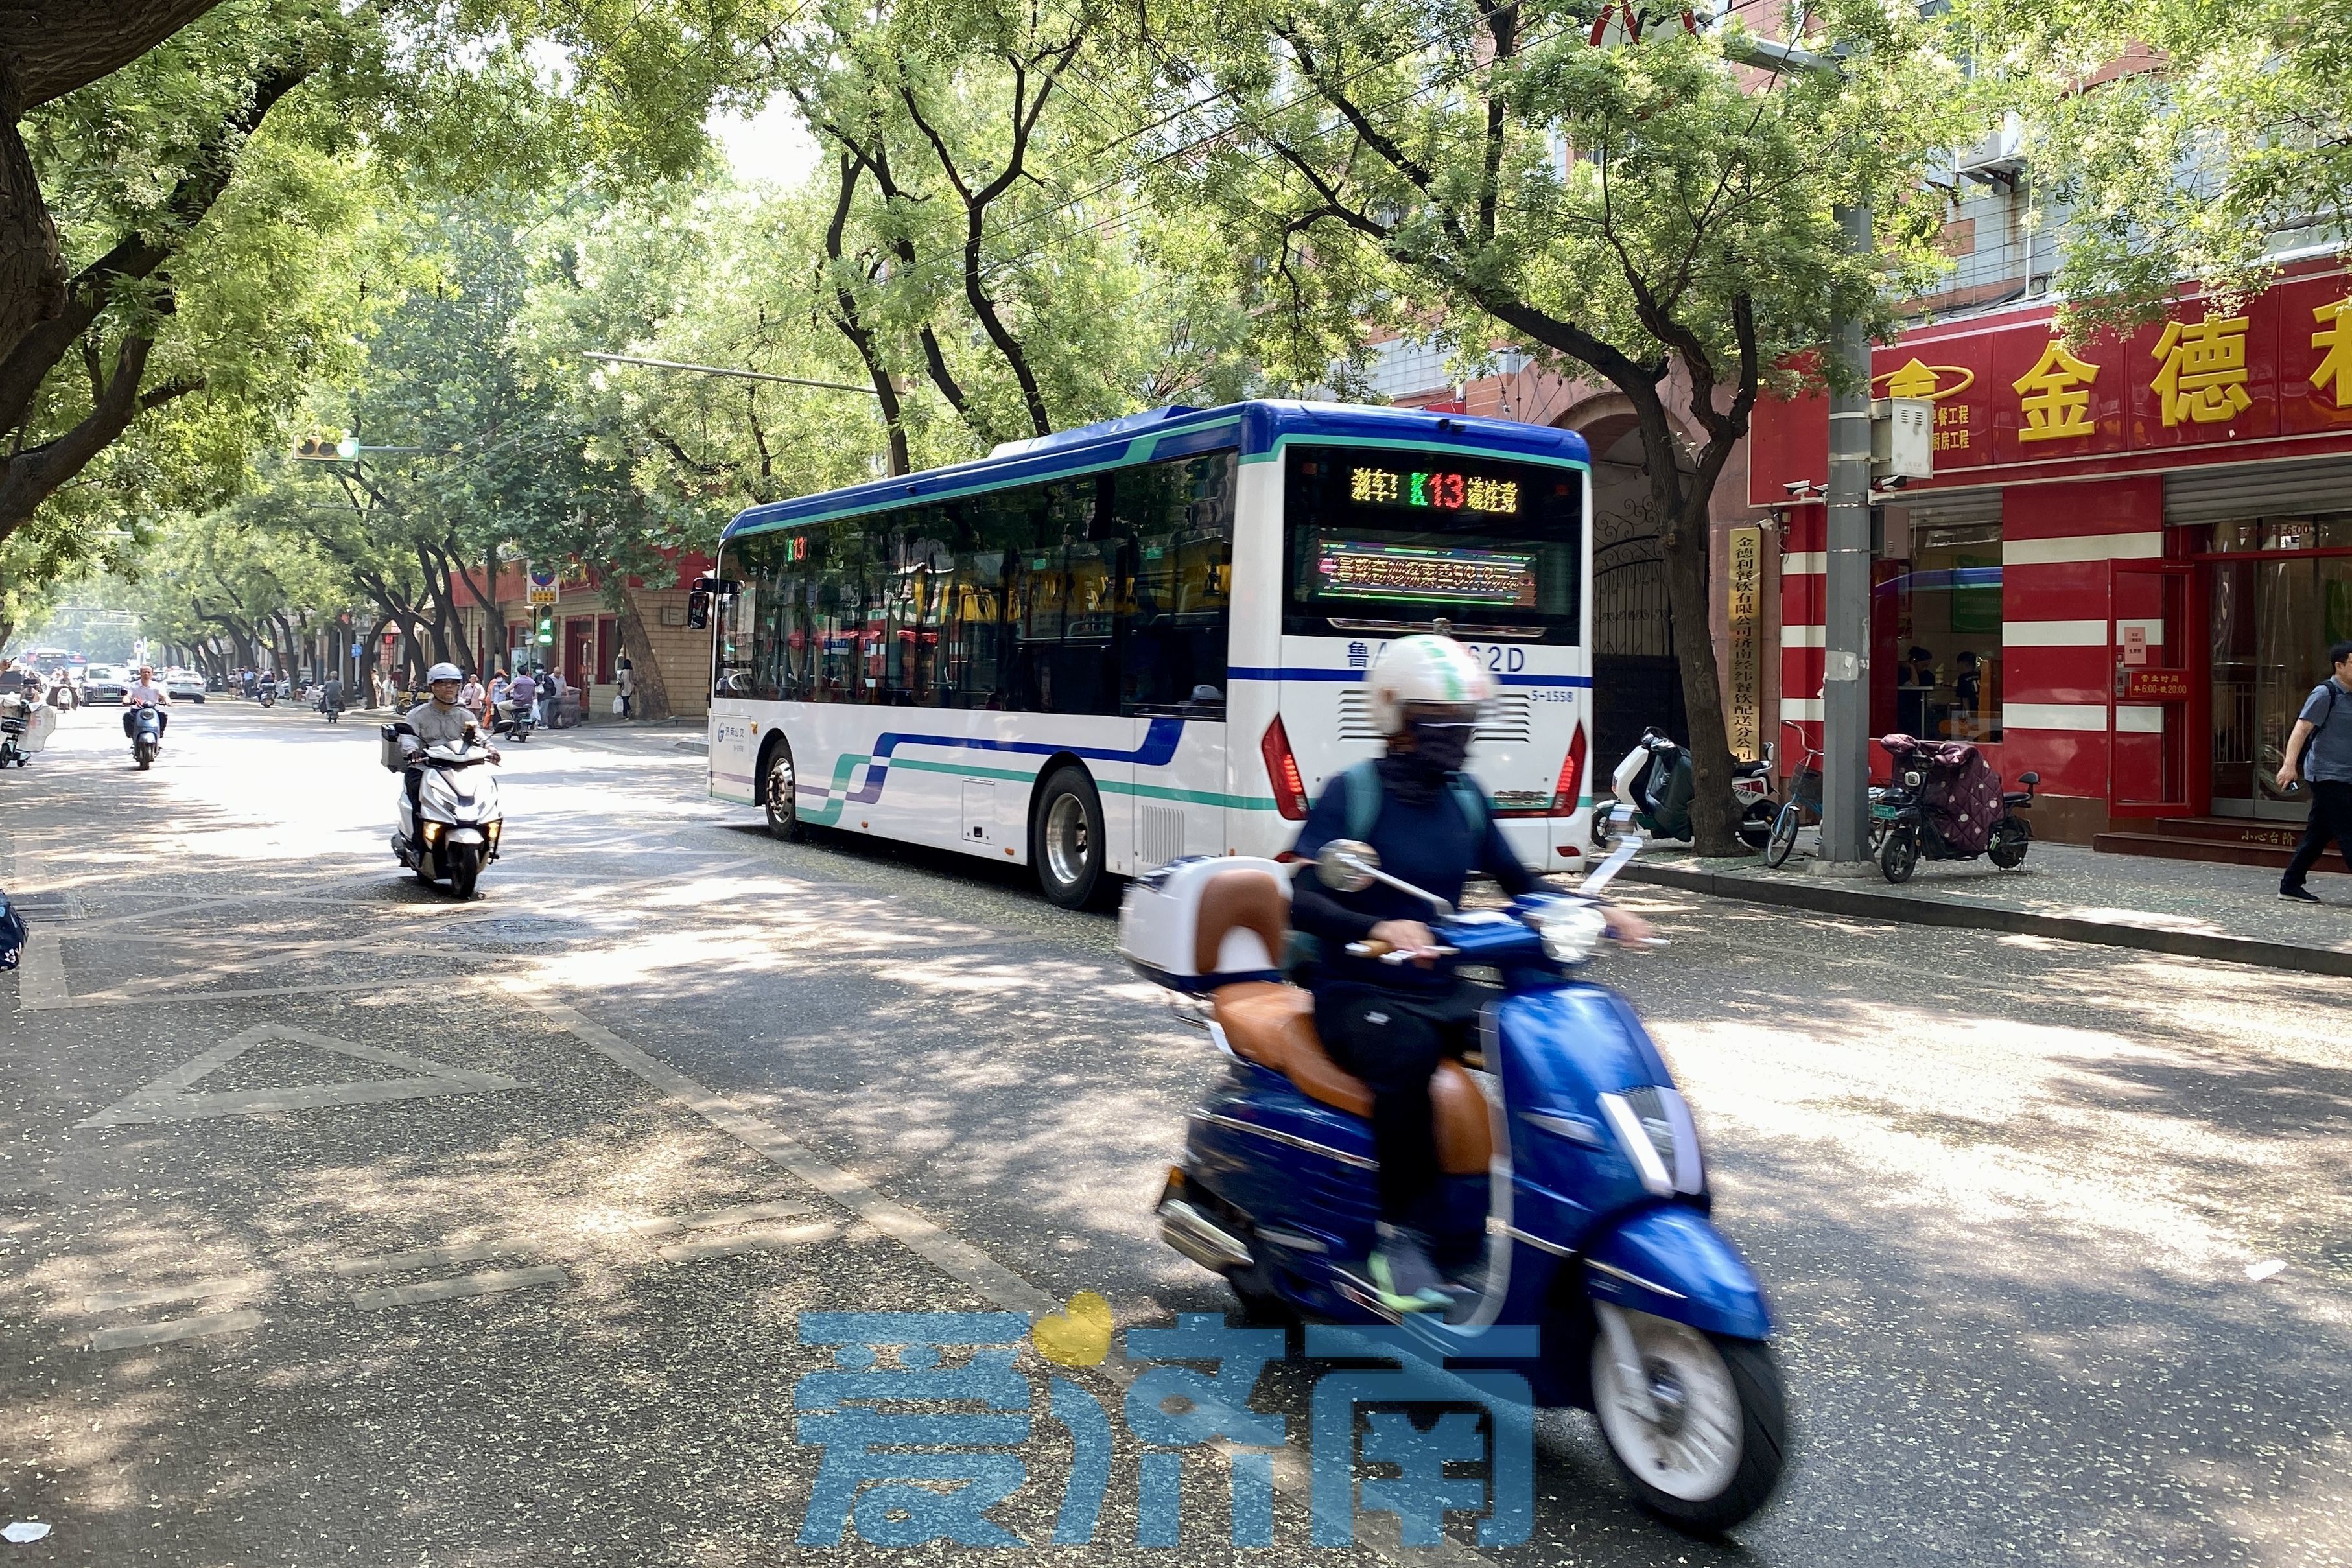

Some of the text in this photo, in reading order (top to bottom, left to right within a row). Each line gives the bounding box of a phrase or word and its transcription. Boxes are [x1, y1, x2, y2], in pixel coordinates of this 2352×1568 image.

[1411, 473, 1464, 508] K13
[1734, 537, 1754, 760] 金德利餐饮有限公司济南经纬餐饮配送分公司
[1532, 690, 1574, 702] 5-1558
[2241, 830, 2296, 846] 小心台阶
